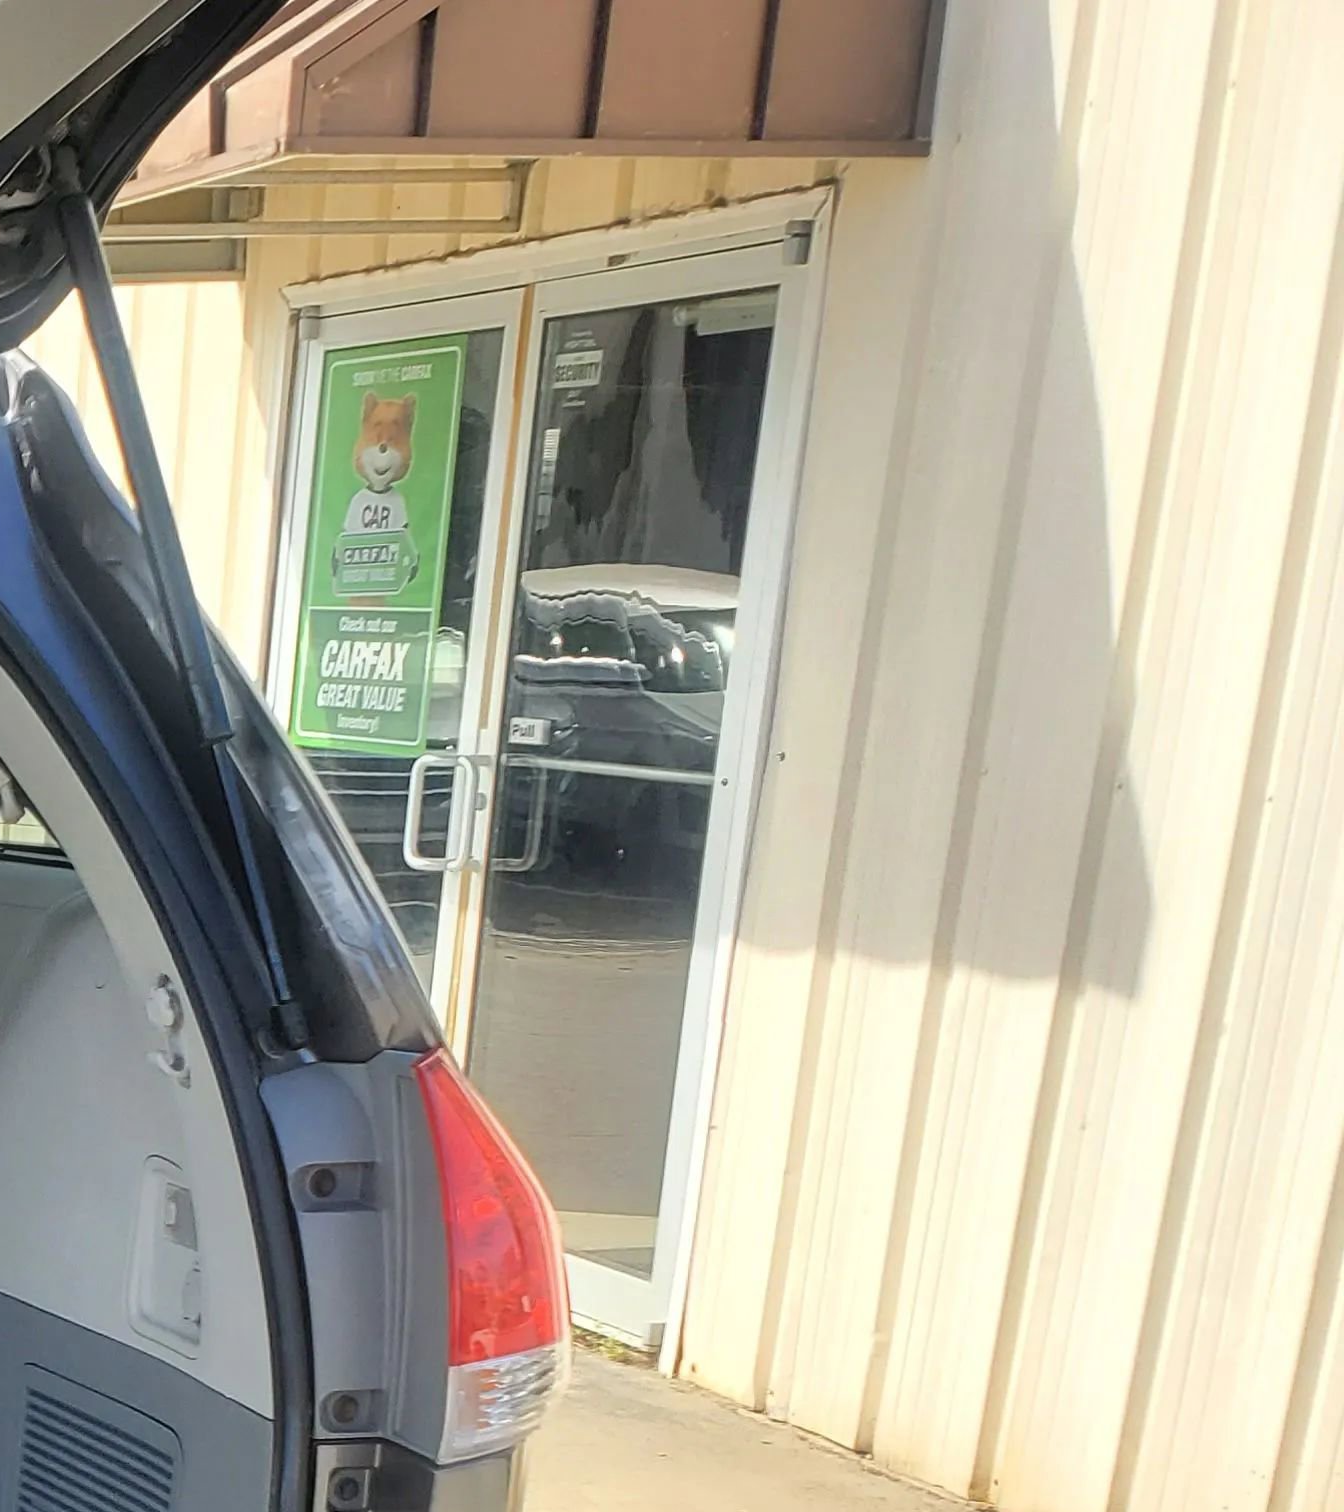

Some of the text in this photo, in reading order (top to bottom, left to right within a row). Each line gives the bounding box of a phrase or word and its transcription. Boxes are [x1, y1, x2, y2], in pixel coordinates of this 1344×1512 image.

[362, 504, 390, 529] CAR
[320, 639, 411, 681] CARFAX
[316, 682, 407, 712] GREAT VALUE
[512, 724, 535, 737] Pull
